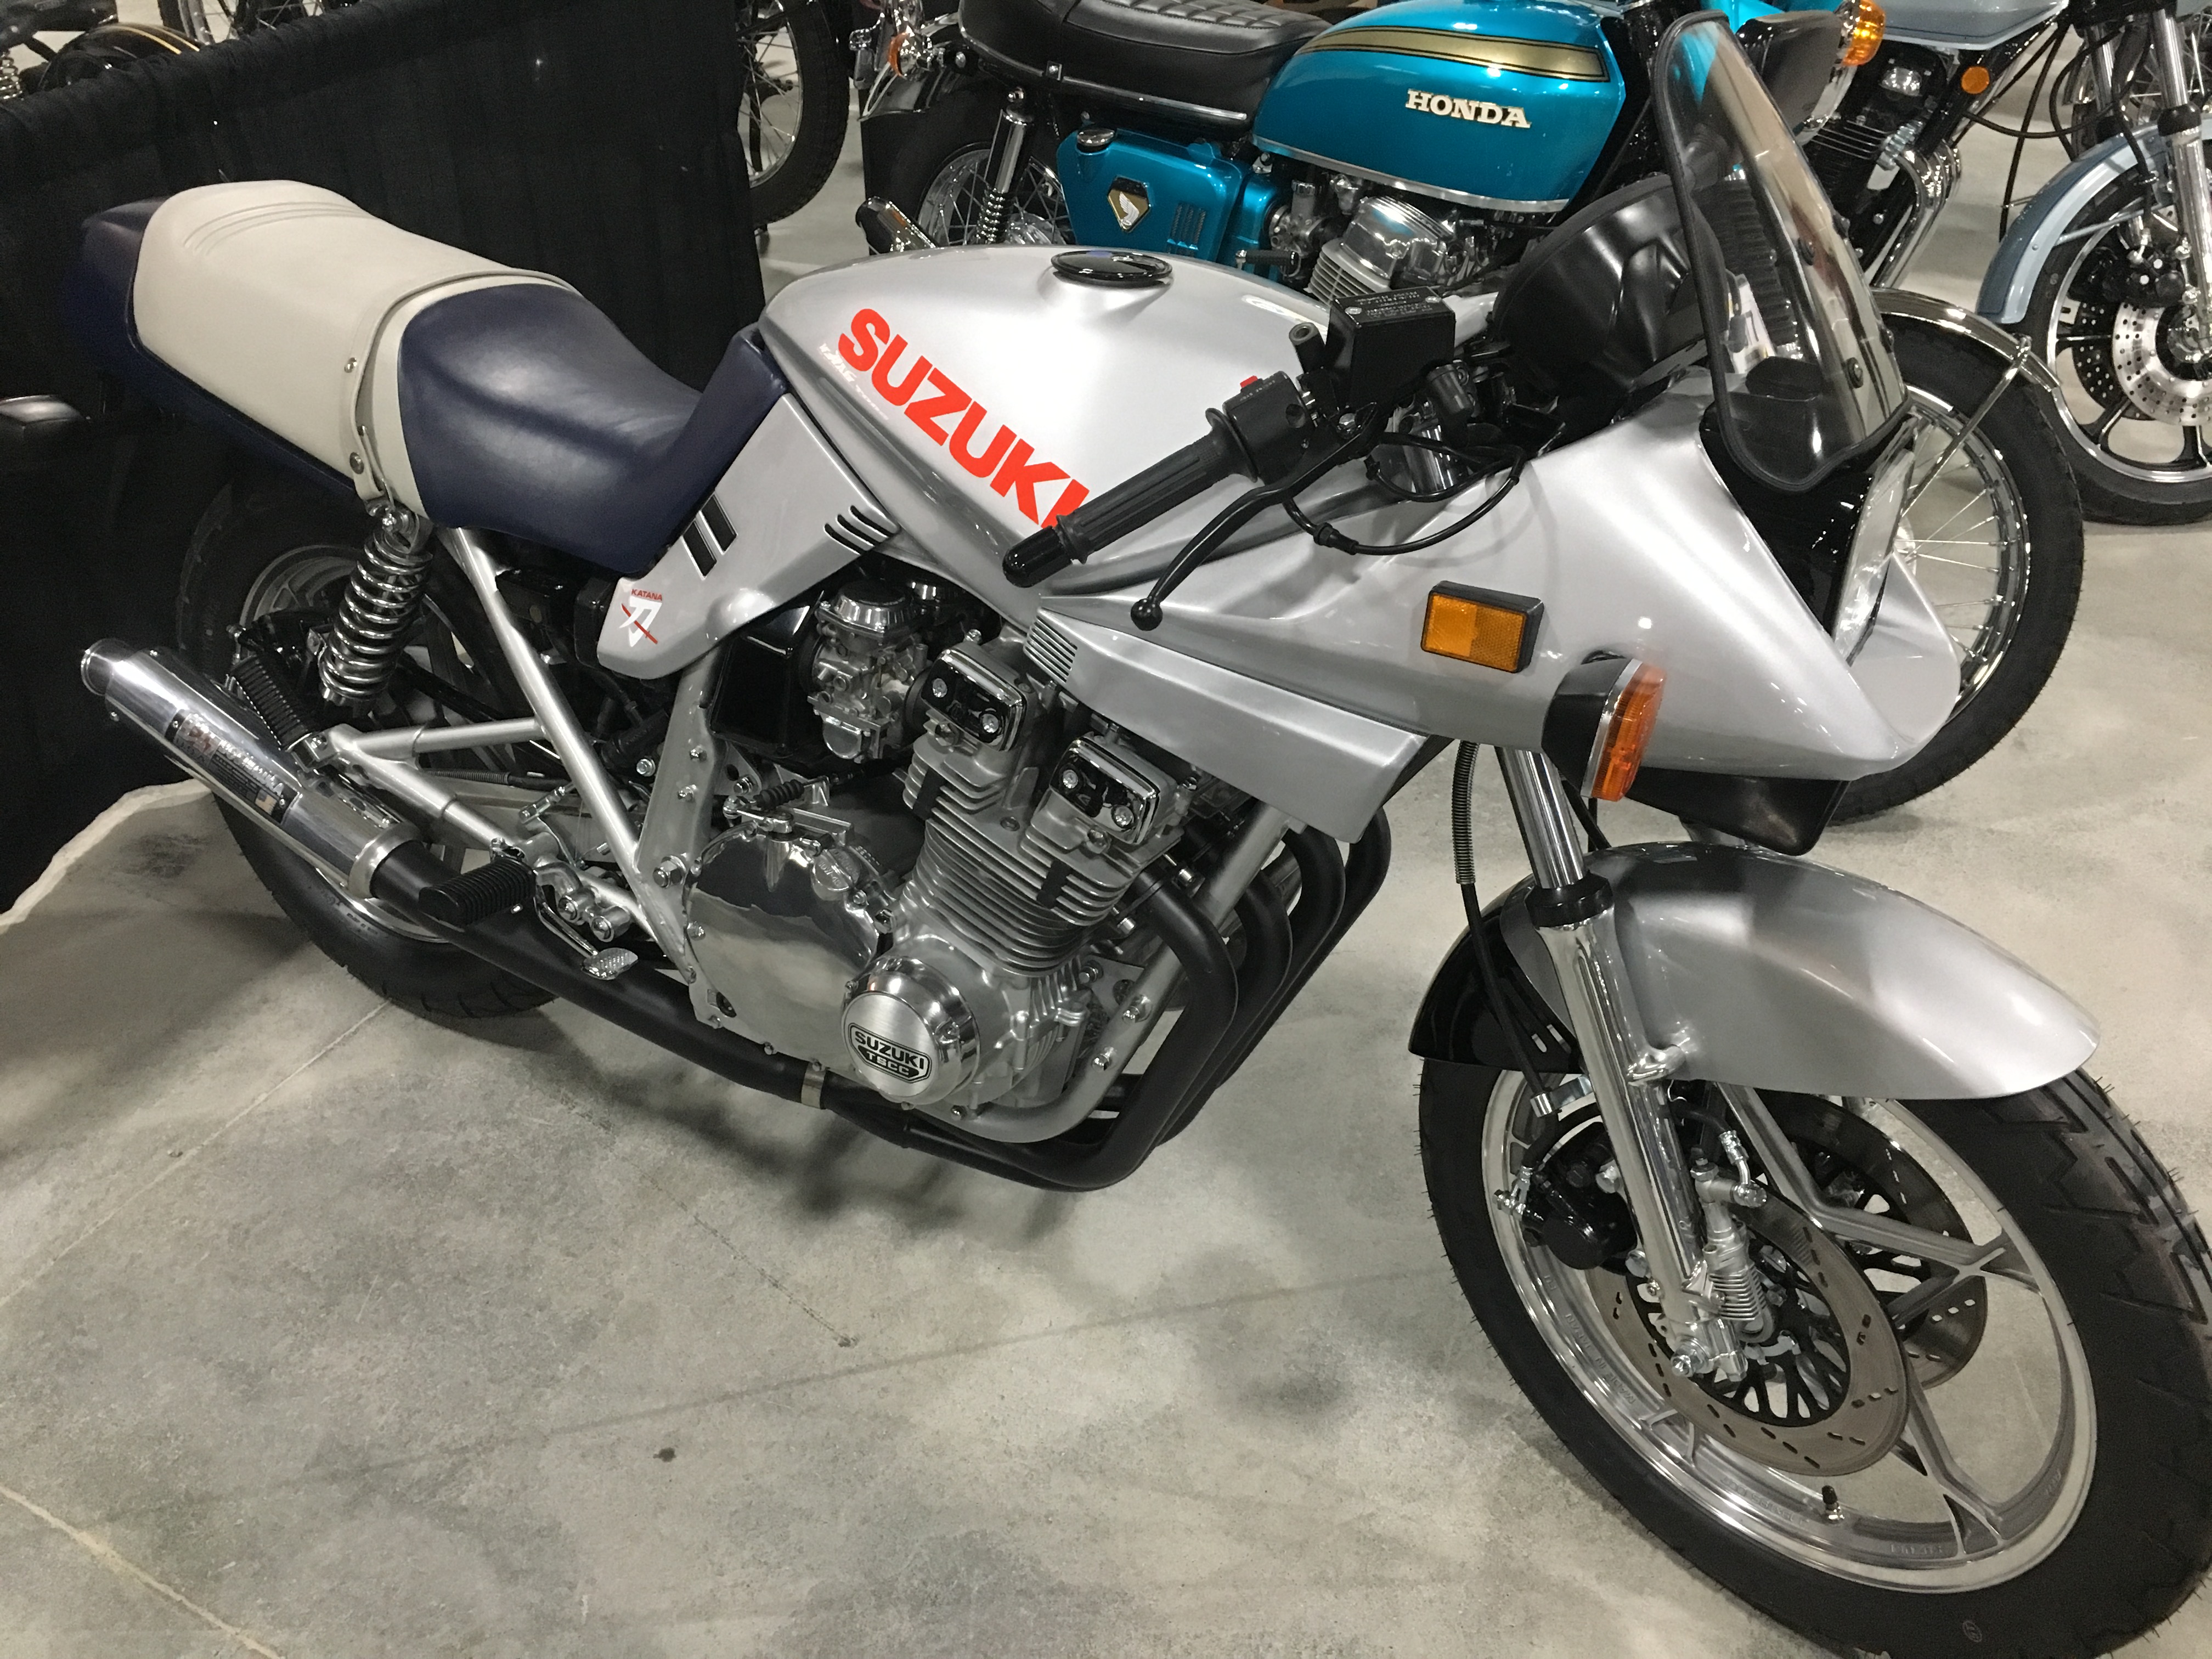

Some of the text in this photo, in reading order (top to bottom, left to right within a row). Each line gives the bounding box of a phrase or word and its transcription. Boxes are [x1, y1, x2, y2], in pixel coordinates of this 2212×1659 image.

[1406, 88, 1532, 128] HONDA
[838, 308, 1090, 529] SUZUKI
[631, 589, 663, 601] KATANA
[855, 1030, 924, 1070] SUZUKI
[867, 1051, 910, 1076] TSCC
[1565, 1313, 1591, 1348] JAPAN
[1595, 1357, 1607, 1369] IN
[1609, 1374, 1636, 1404] MADE
[1720, 1476, 1748, 1497] DOT
